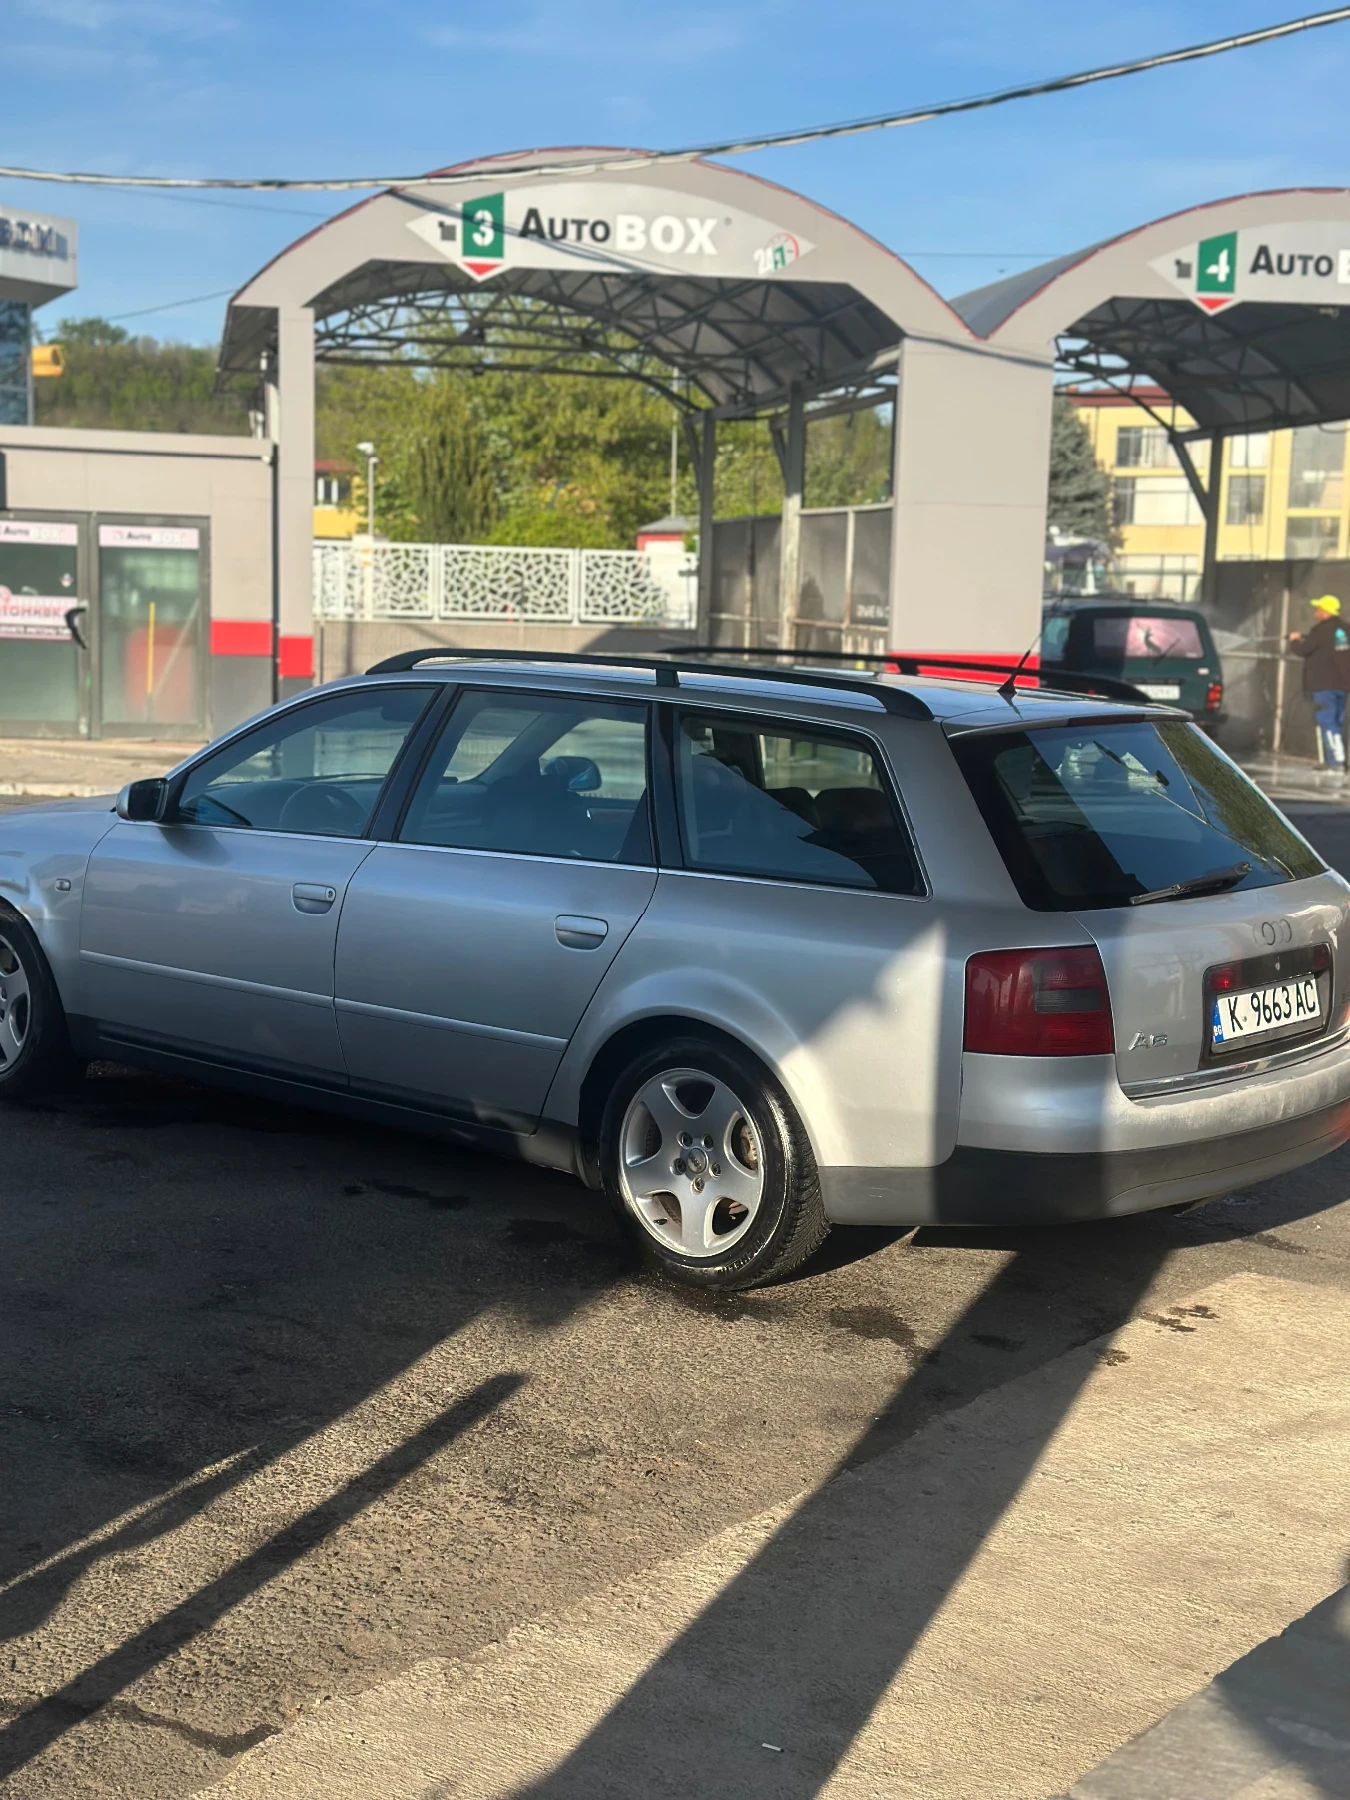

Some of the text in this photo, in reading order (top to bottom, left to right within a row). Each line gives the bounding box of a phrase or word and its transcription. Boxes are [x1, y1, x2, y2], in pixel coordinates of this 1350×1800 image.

[472, 208, 495, 248] 3
[615, 213, 719, 256] BOX
[1205, 248, 1231, 283] 4
[1249, 244, 1334, 278] AUTO
[1227, 979, 1316, 1033] K 9663 AC
[1128, 1030, 1168, 1051] A6
[1213, 1024, 1223, 1037] BG
